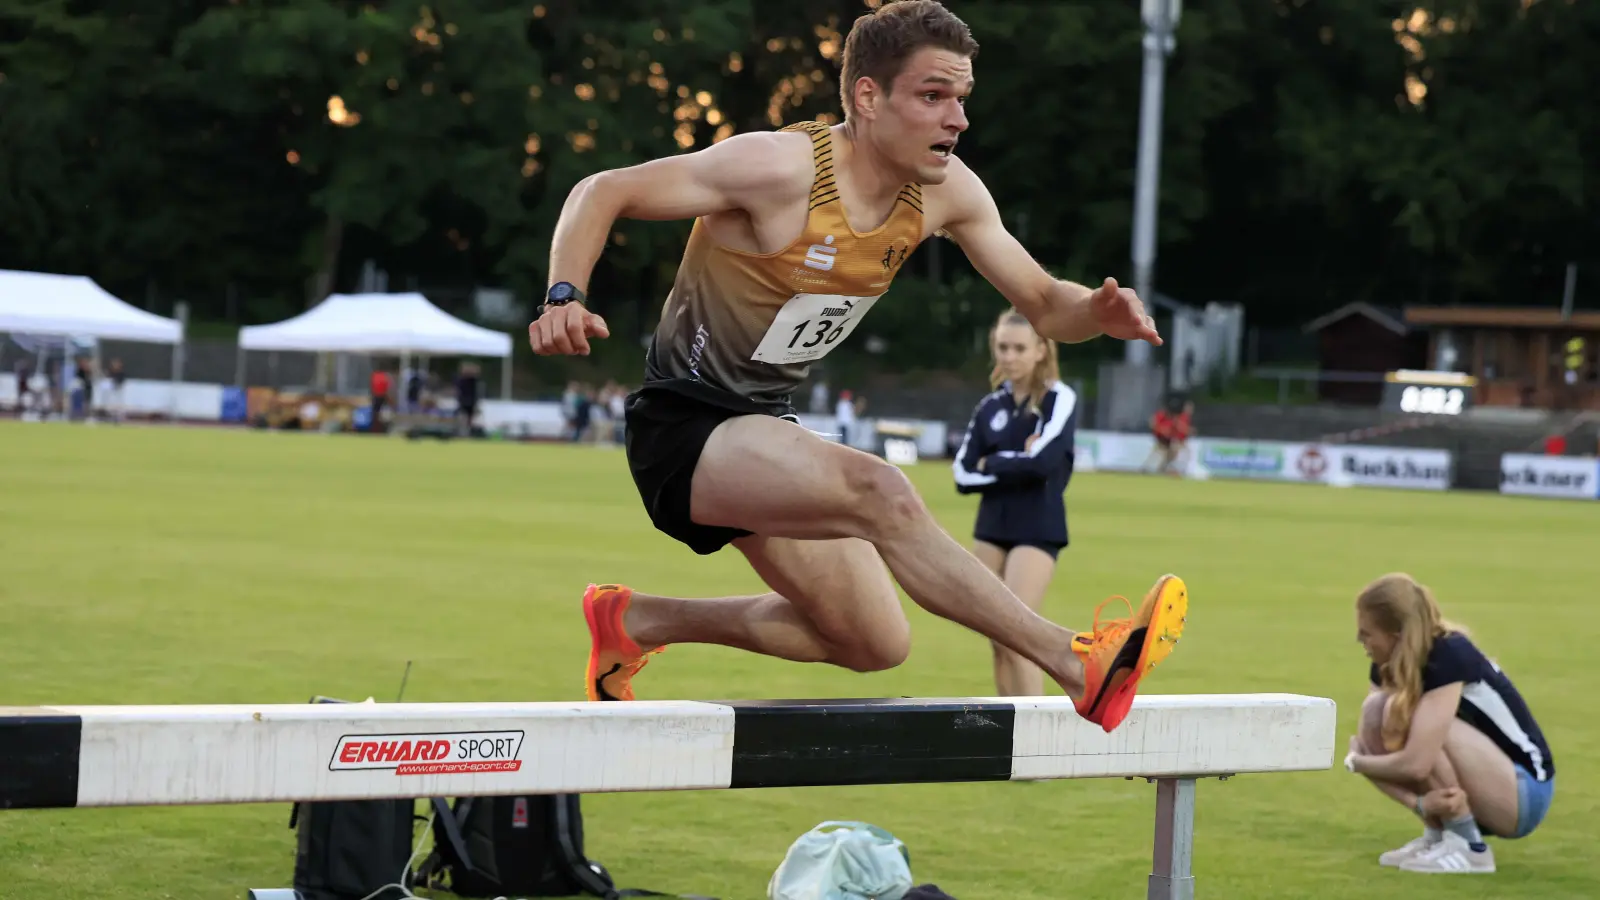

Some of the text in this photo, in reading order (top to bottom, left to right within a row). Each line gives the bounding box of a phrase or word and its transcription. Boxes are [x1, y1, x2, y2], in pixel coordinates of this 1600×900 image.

[820, 307, 848, 317] PUMA
[787, 318, 851, 348] 136
[457, 738, 515, 759] SPORT
[399, 762, 518, 774] www.erhard-sport.de
